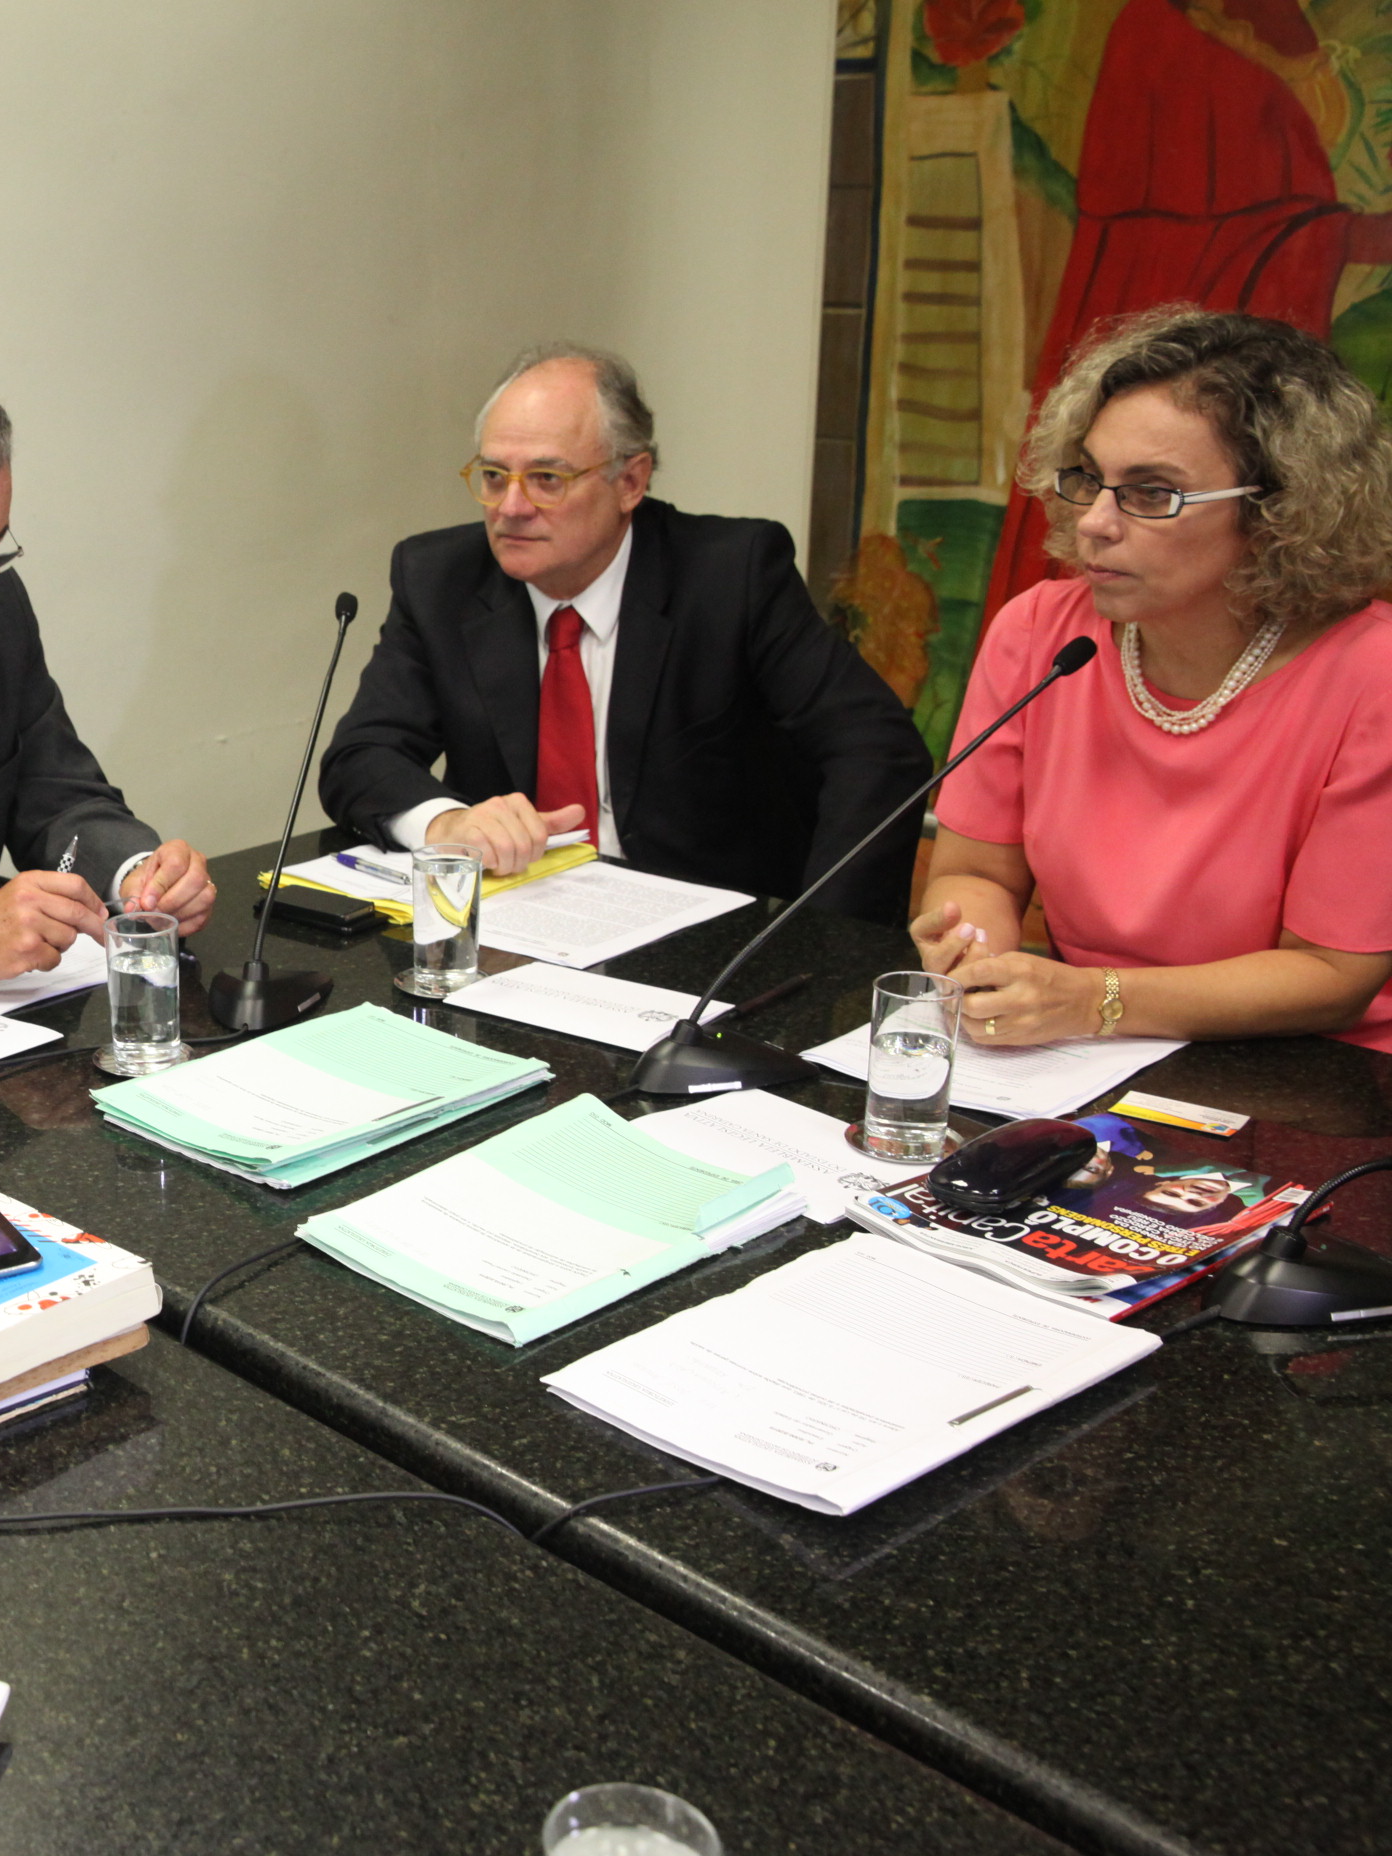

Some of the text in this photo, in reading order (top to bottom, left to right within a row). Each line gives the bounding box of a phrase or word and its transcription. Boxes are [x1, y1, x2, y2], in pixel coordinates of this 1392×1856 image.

[1024, 1210, 1188, 1266] O COMPLÔ
[1047, 1205, 1201, 1257] E TRÊS PERSONAGENS
